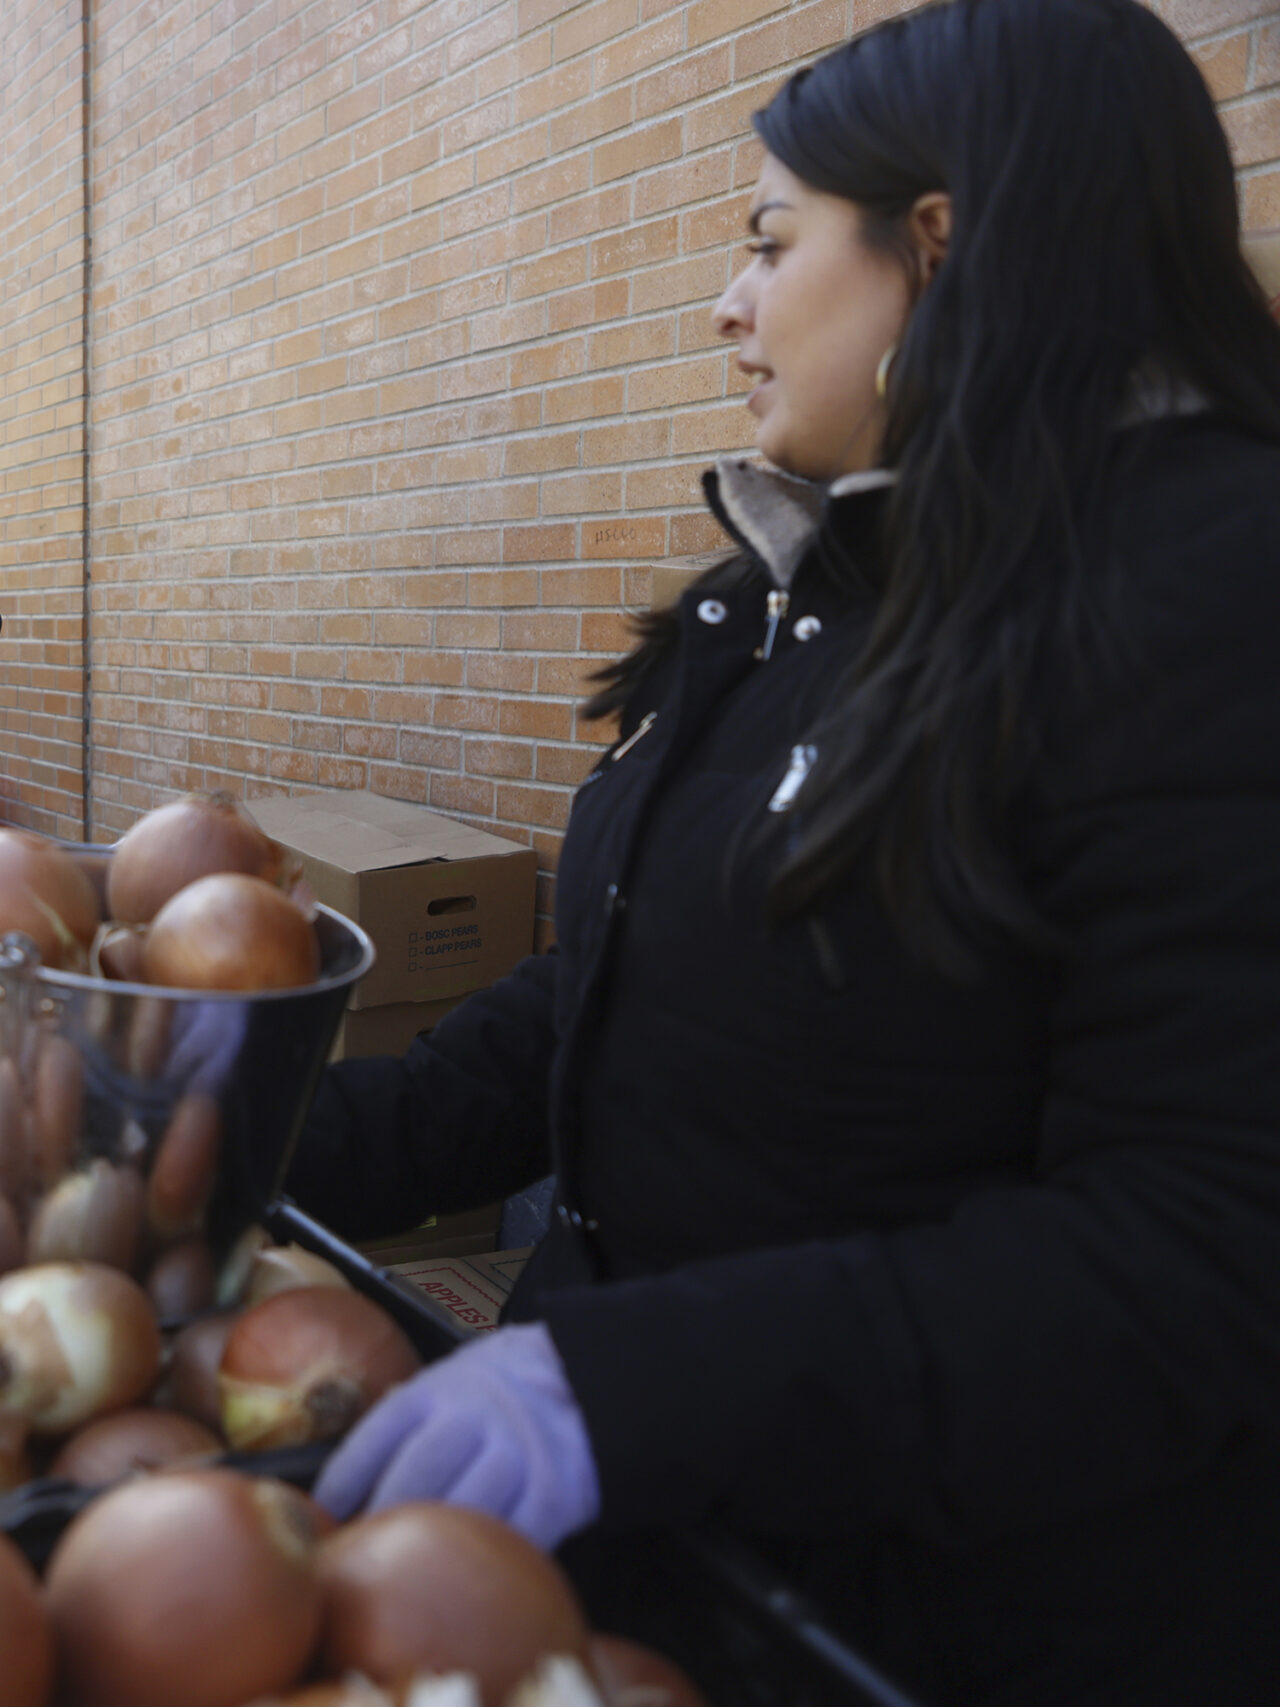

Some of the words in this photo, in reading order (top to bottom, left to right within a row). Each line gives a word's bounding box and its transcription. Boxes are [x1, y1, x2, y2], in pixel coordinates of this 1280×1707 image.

[425, 929, 450, 942] BOSC
[451, 925, 478, 937] PEARS
[424, 943, 453, 956] CLAPP
[455, 938, 481, 951] PEARS
[418, 1281, 489, 1325] APPLES
